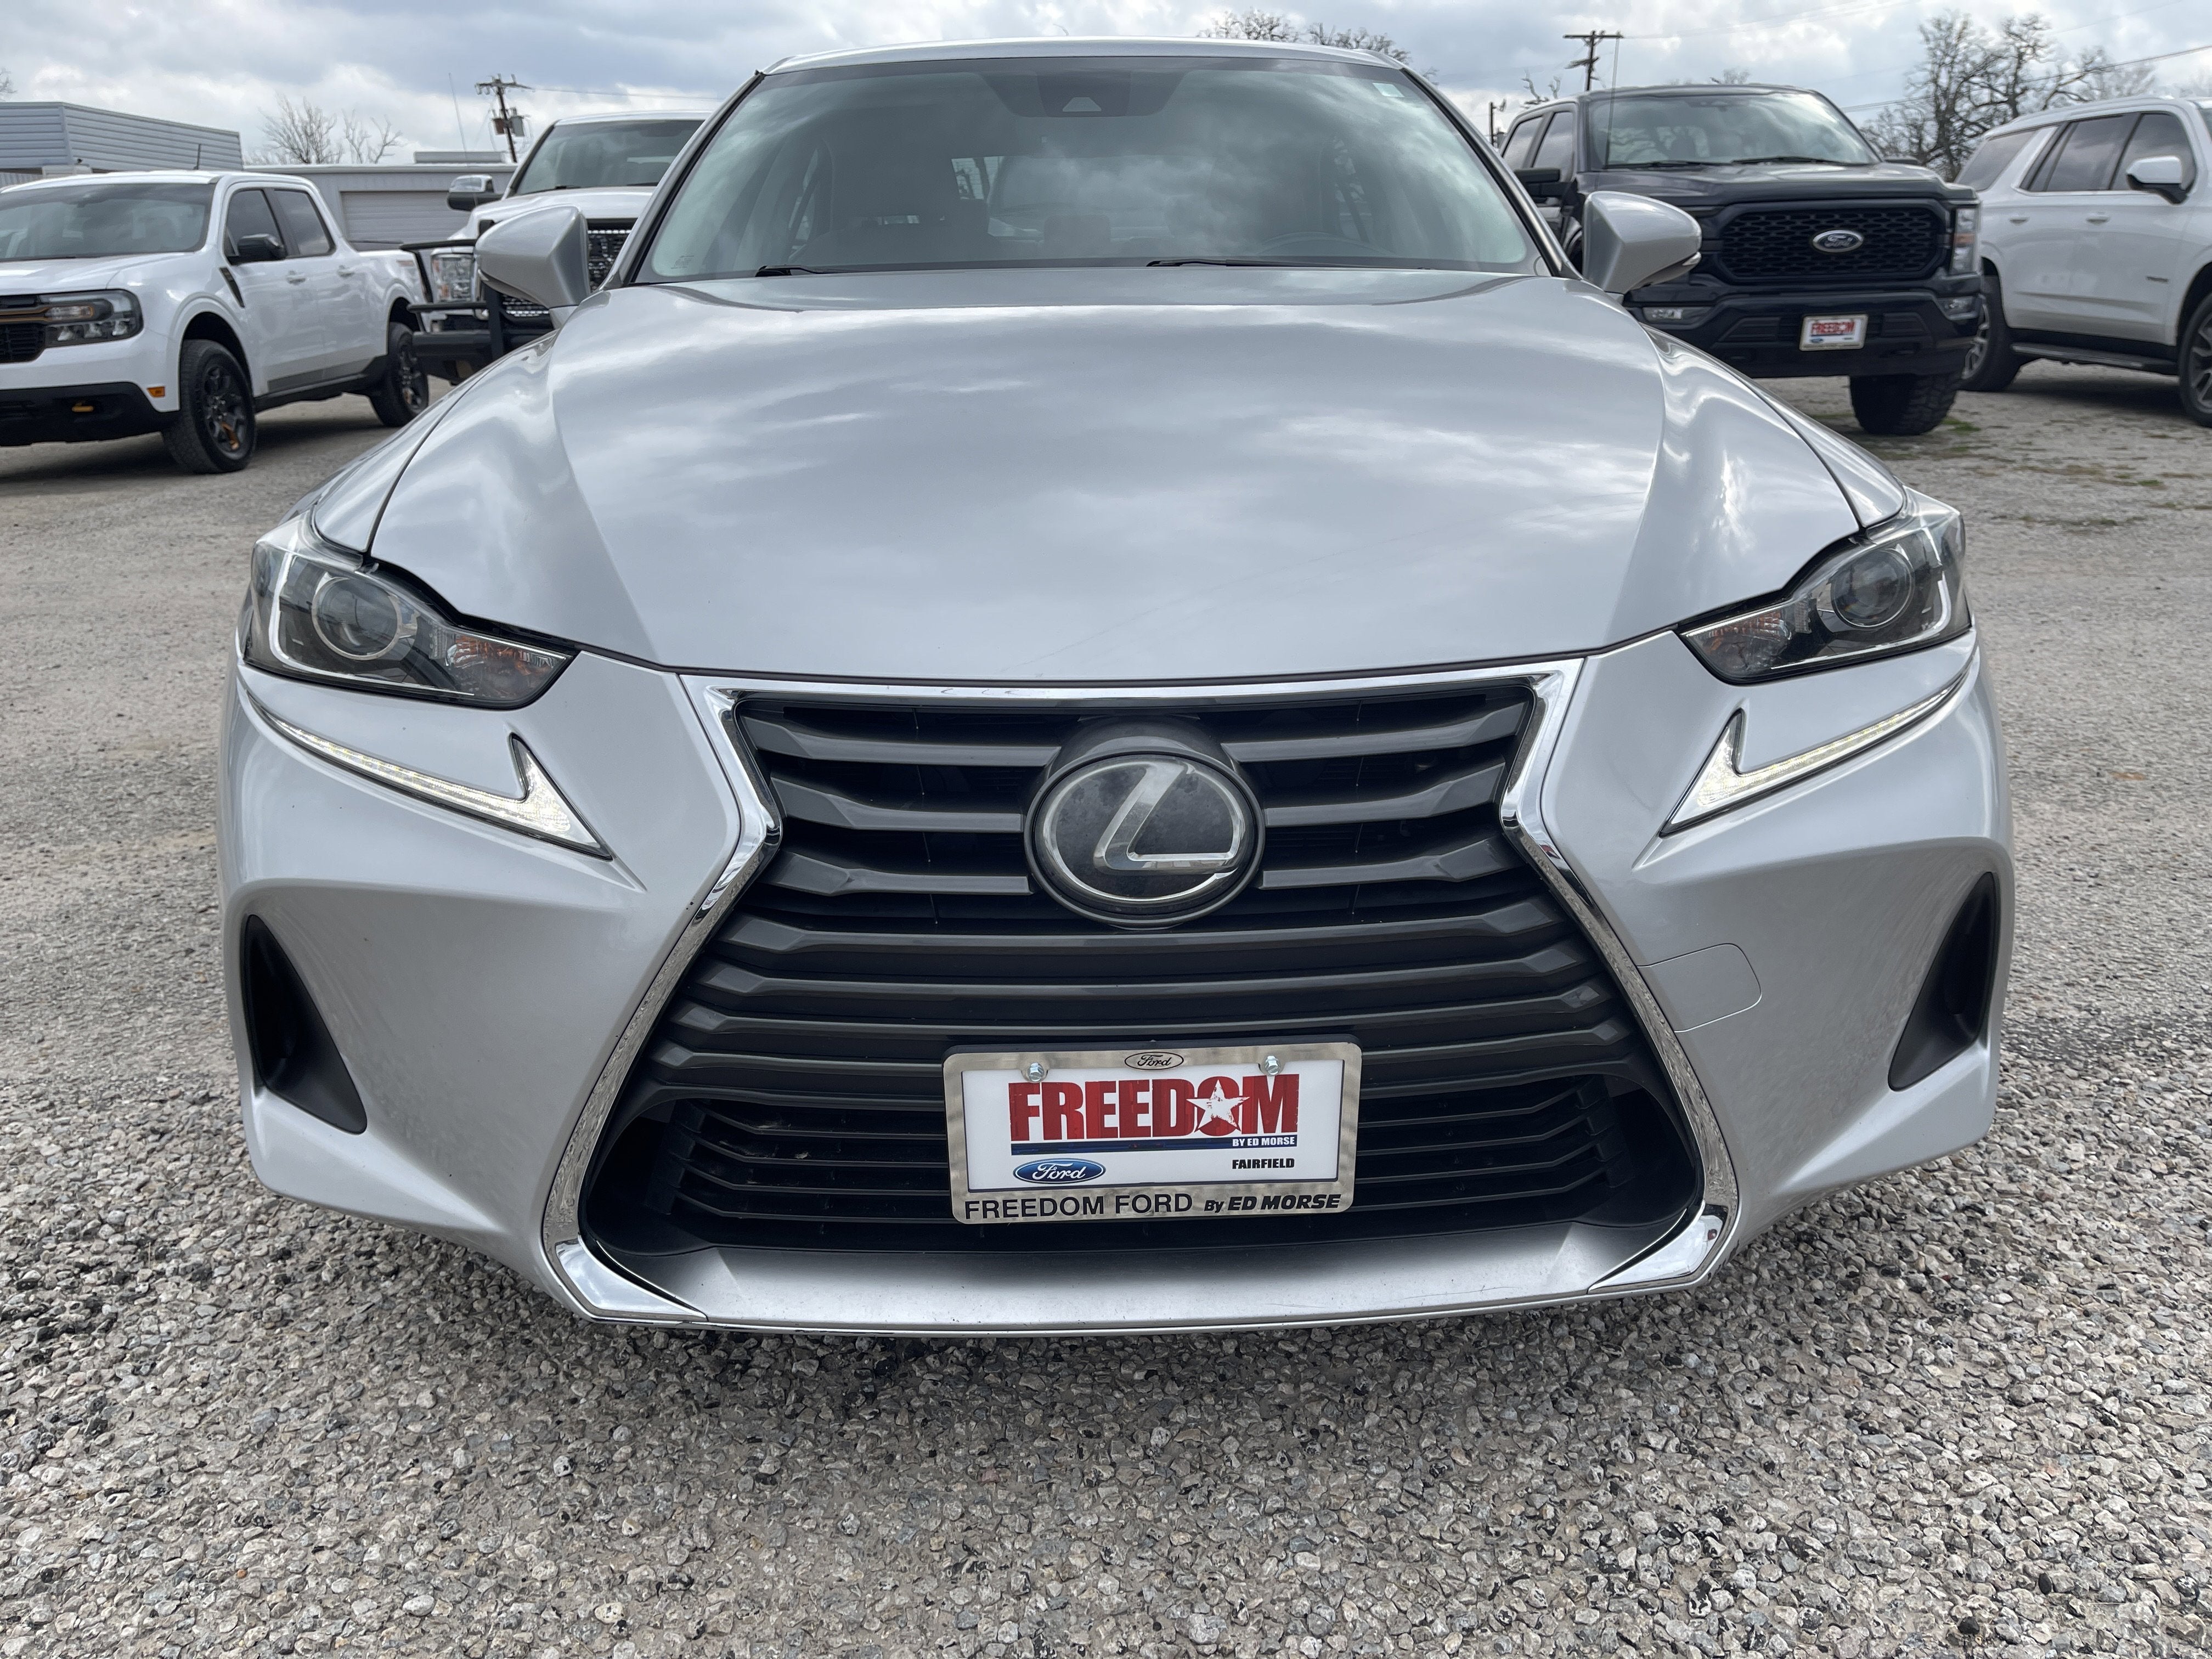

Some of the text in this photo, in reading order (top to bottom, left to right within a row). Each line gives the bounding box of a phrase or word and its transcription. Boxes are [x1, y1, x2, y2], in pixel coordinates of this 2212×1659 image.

[1137, 1054, 1172, 1066] Ford
[1008, 1073, 1300, 1141] FREEDOM
[1232, 1136, 1295, 1147] BY ED MORSE
[1232, 1158, 1295, 1169] FAIRFIELD
[1032, 1163, 1087, 1180] Ford
[964, 1193, 1341, 1219] FREEDOM FORD By ED MORSE
